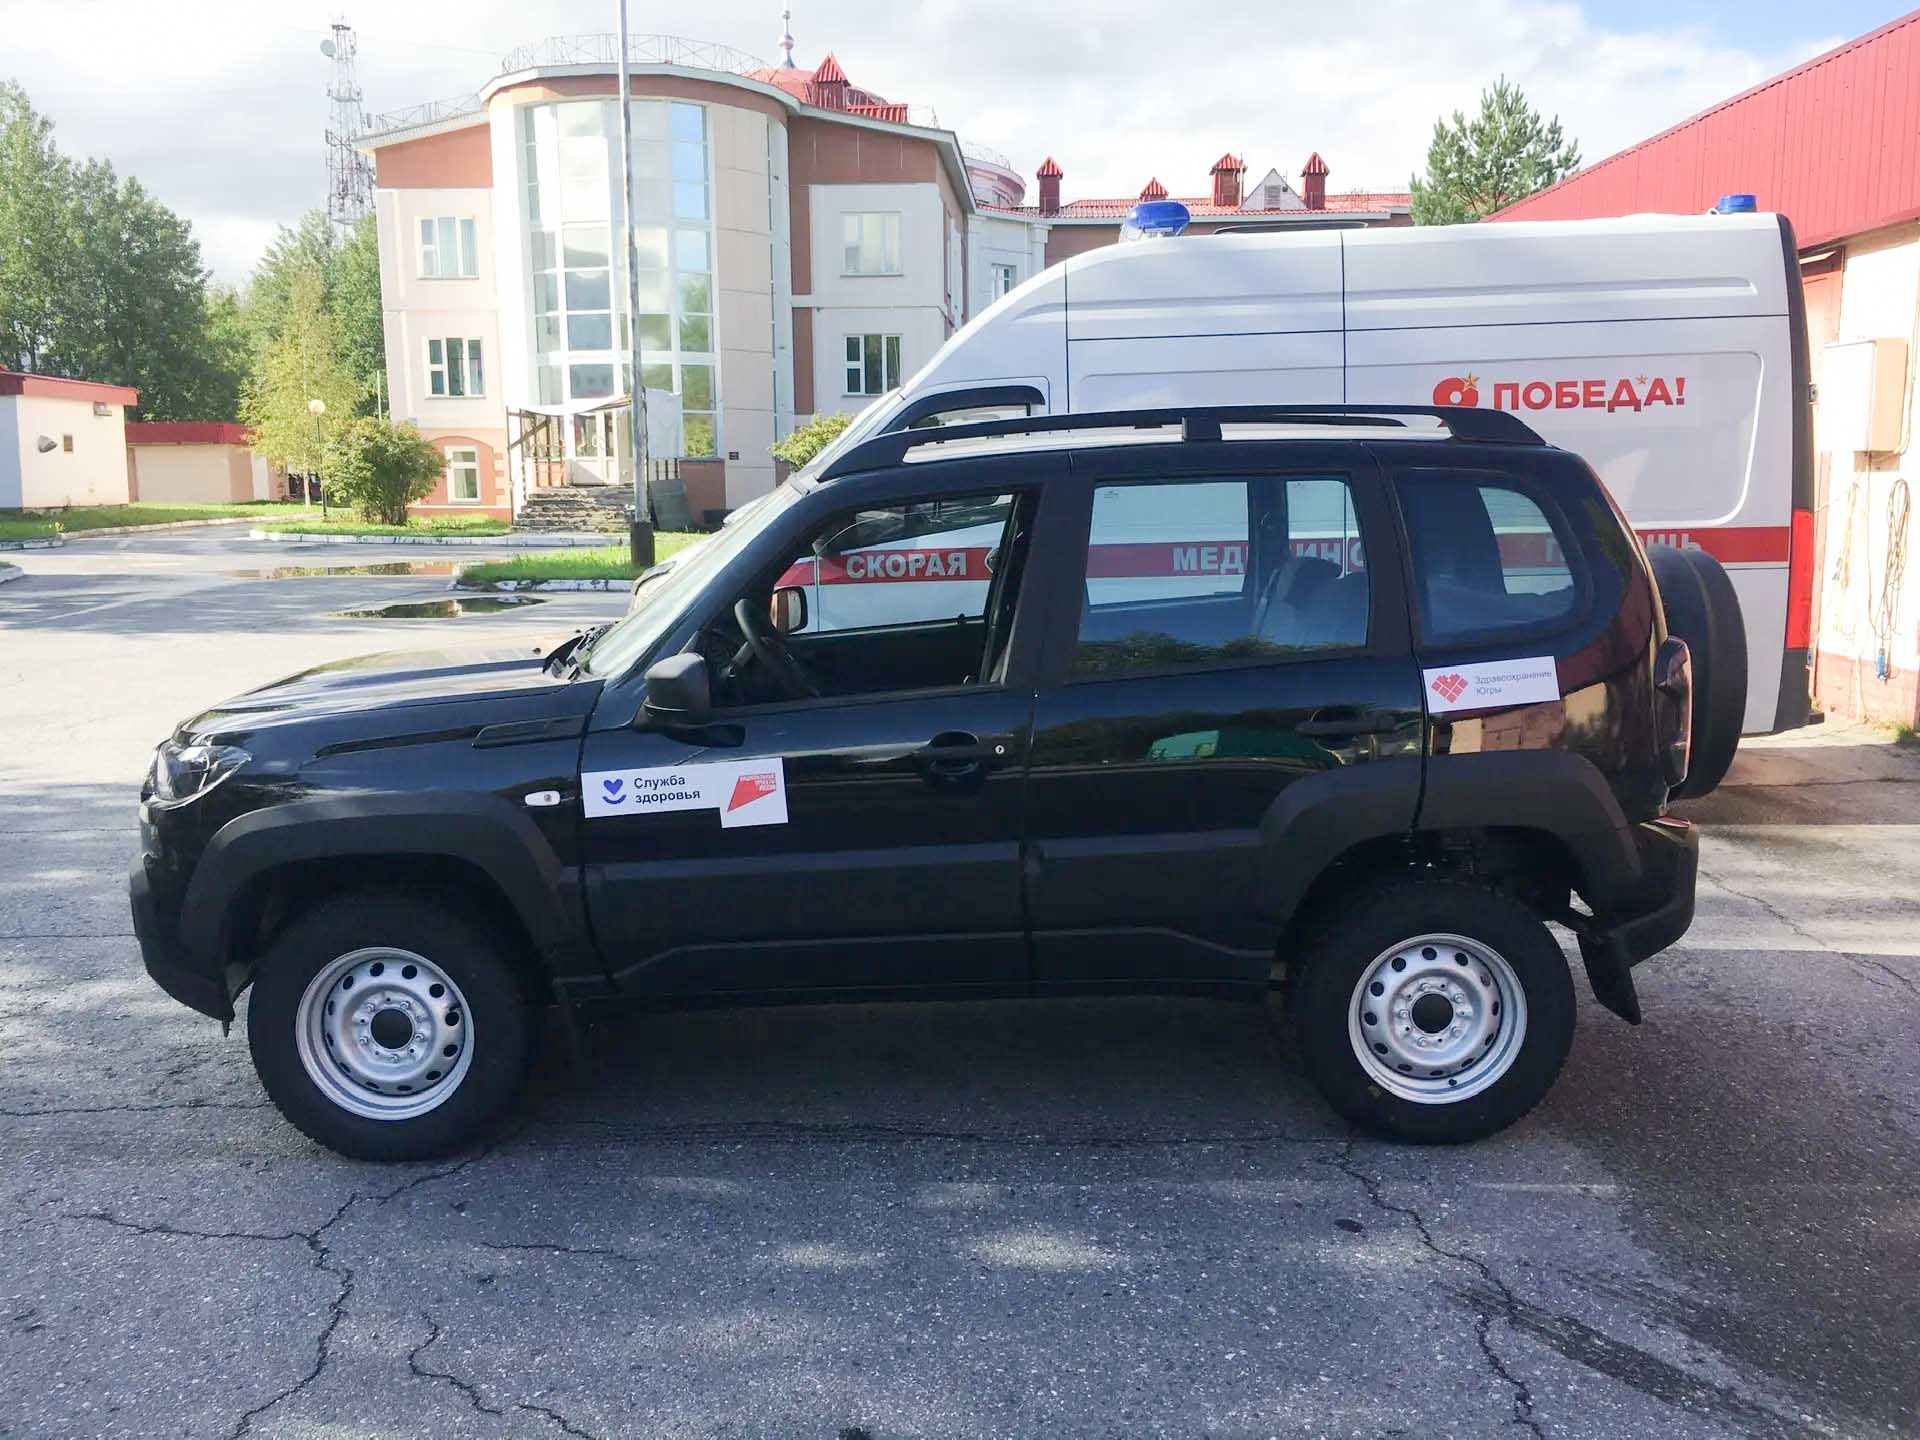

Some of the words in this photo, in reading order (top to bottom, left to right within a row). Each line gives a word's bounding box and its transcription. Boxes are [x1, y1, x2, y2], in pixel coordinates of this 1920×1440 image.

[1493, 377, 1686, 413] ПОБЕДА!
[846, 552, 967, 578] СКОРАЯ
[1475, 671, 1552, 684] Здравоохранение
[1476, 687, 1502, 696] Югры
[635, 775, 685, 790] Служба
[636, 790, 700, 804] здоровья
